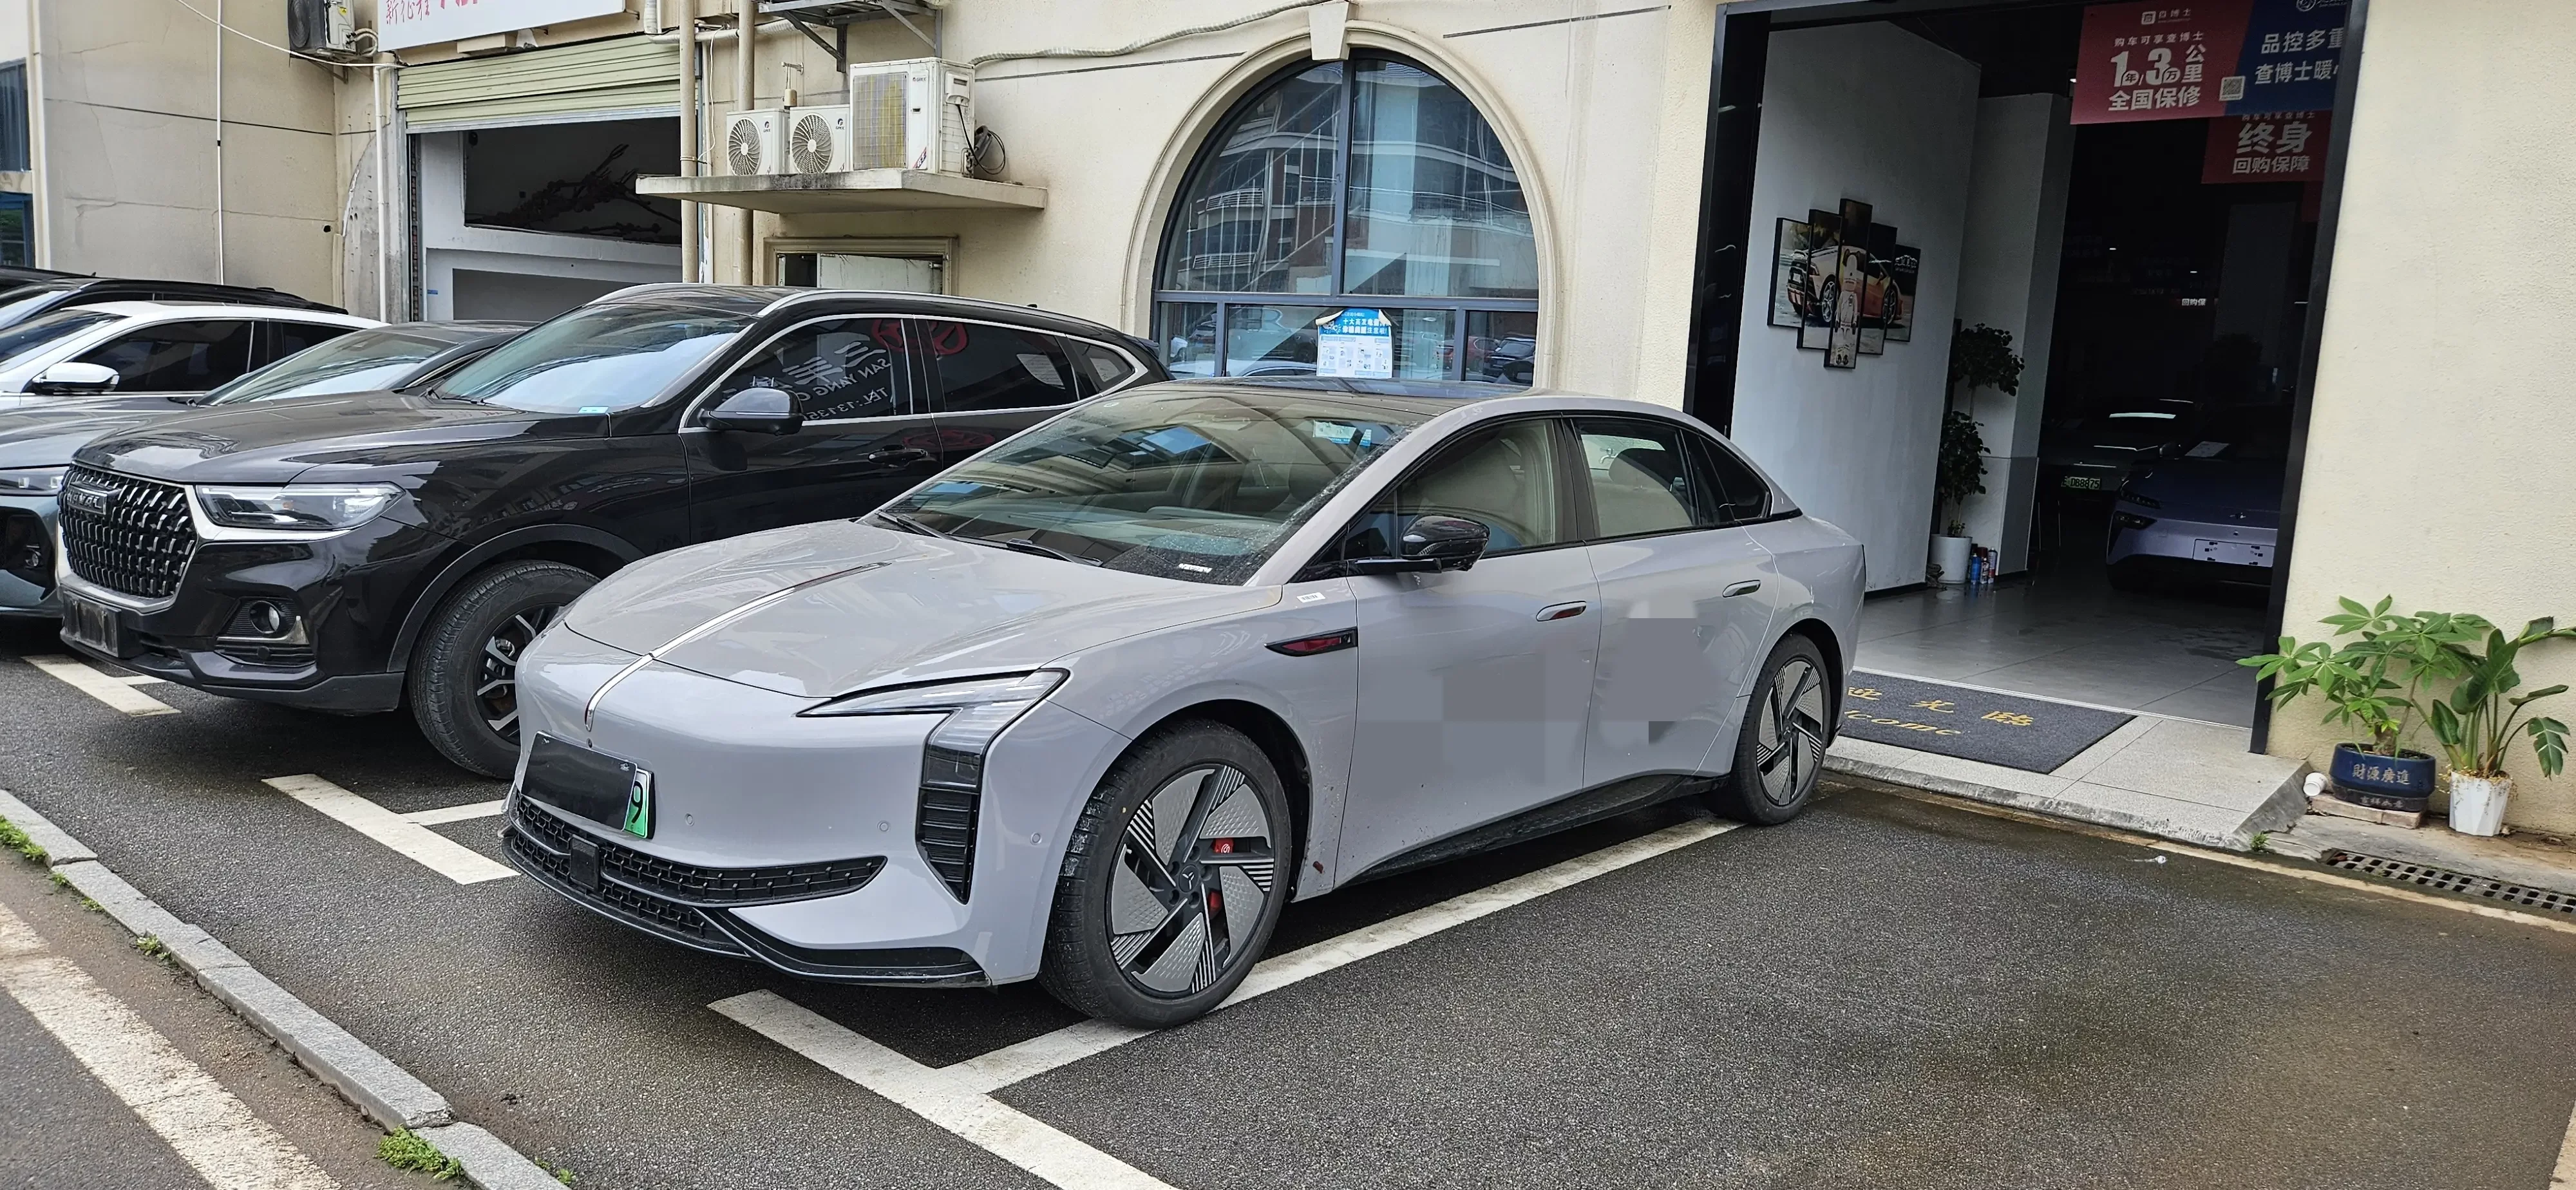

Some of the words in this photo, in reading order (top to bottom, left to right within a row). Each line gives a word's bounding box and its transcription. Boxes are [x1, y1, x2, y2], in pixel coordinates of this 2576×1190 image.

[2261, 28, 2345, 54] 品控多重
[2108, 85, 2201, 111] 全国保修
[2236, 120, 2313, 154] 终身
[2232, 155, 2311, 174] 回购保障
[67, 489, 102, 509] HAVAL
[2353, 764, 2410, 784] 財源廣進
[631, 780, 644, 824] 9
